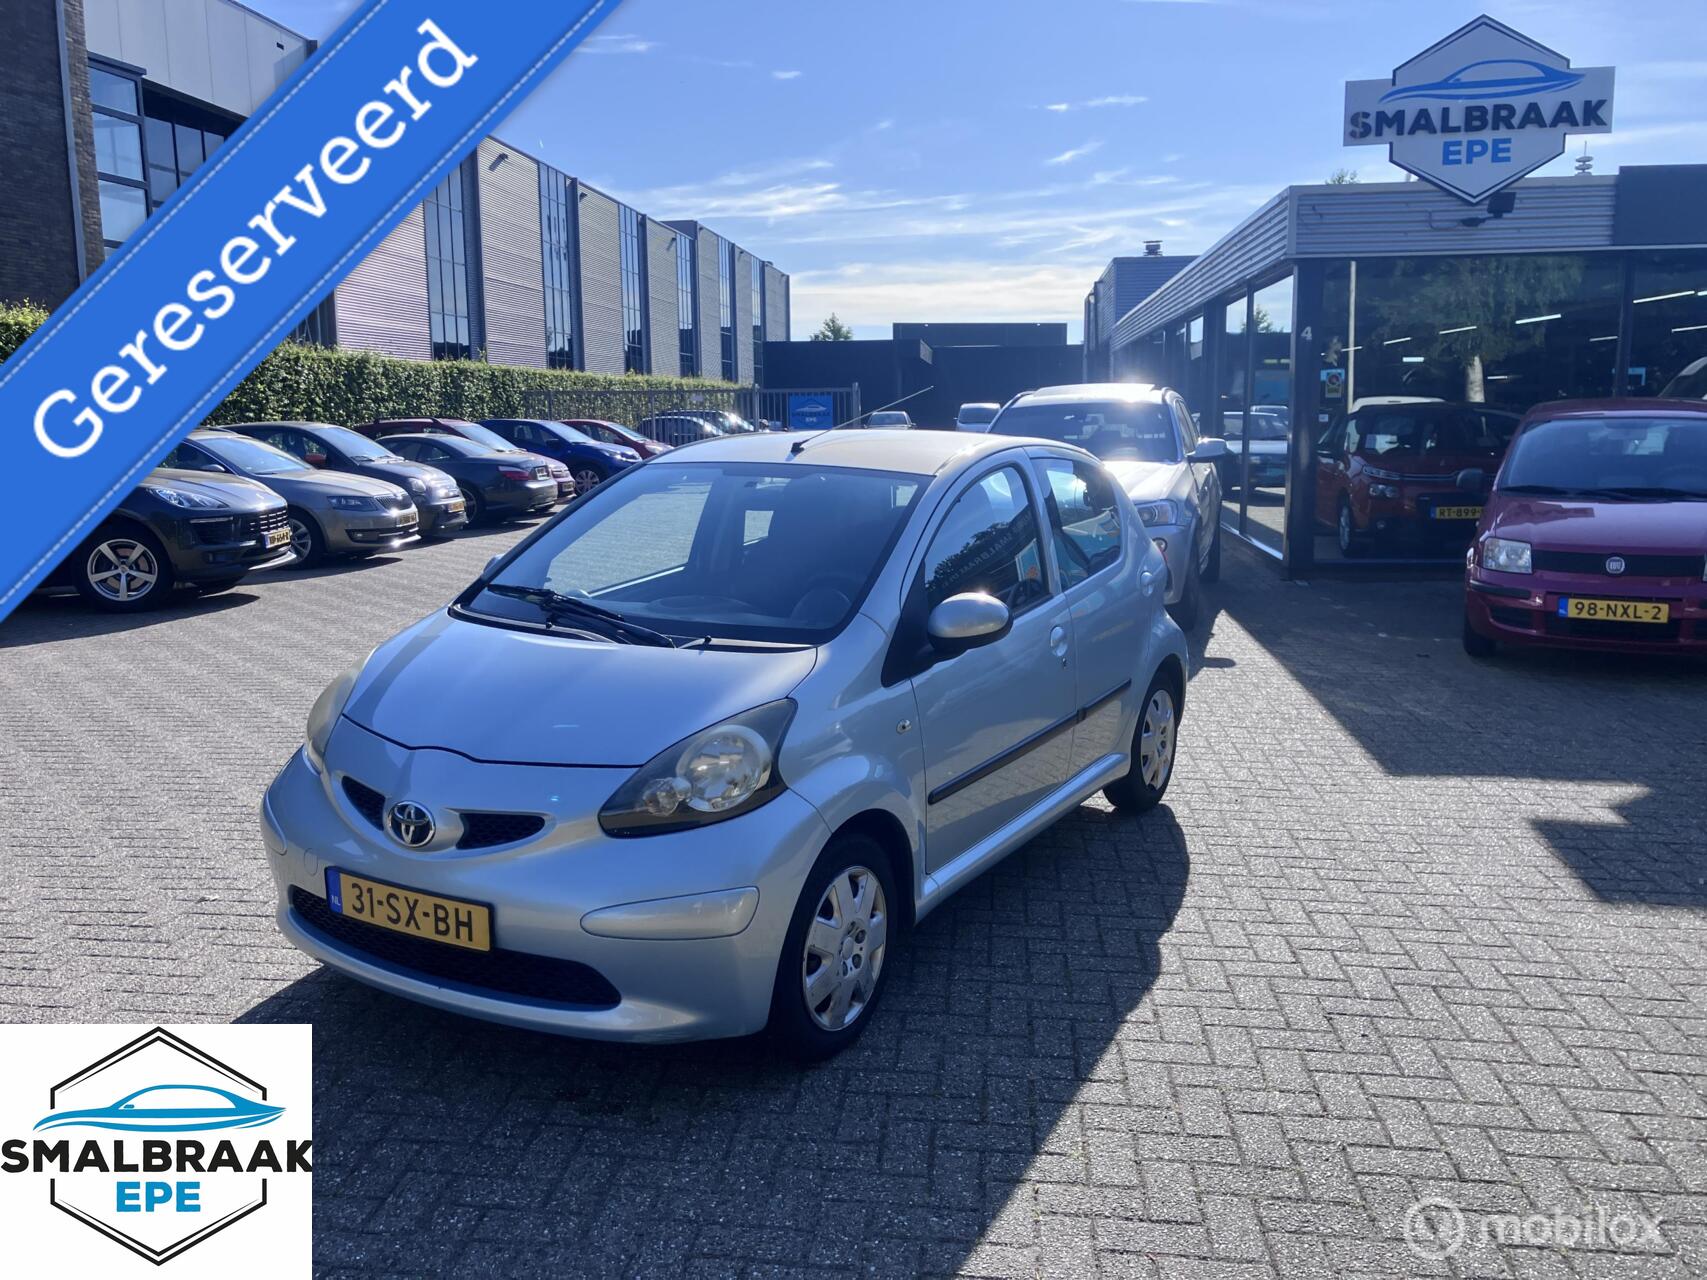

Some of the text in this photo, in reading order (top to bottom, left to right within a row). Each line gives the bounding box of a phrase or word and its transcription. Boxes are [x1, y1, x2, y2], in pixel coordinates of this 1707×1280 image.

[1349, 99, 1608, 139] SMALBRAAK
[1442, 138, 1512, 166] EPE
[1301, 326, 1312, 340] 4
[1439, 507, 1481, 518] RT-899-
[1575, 602, 1662, 620] 98-NXL-2
[352, 883, 473, 942] 31-SX-BH
